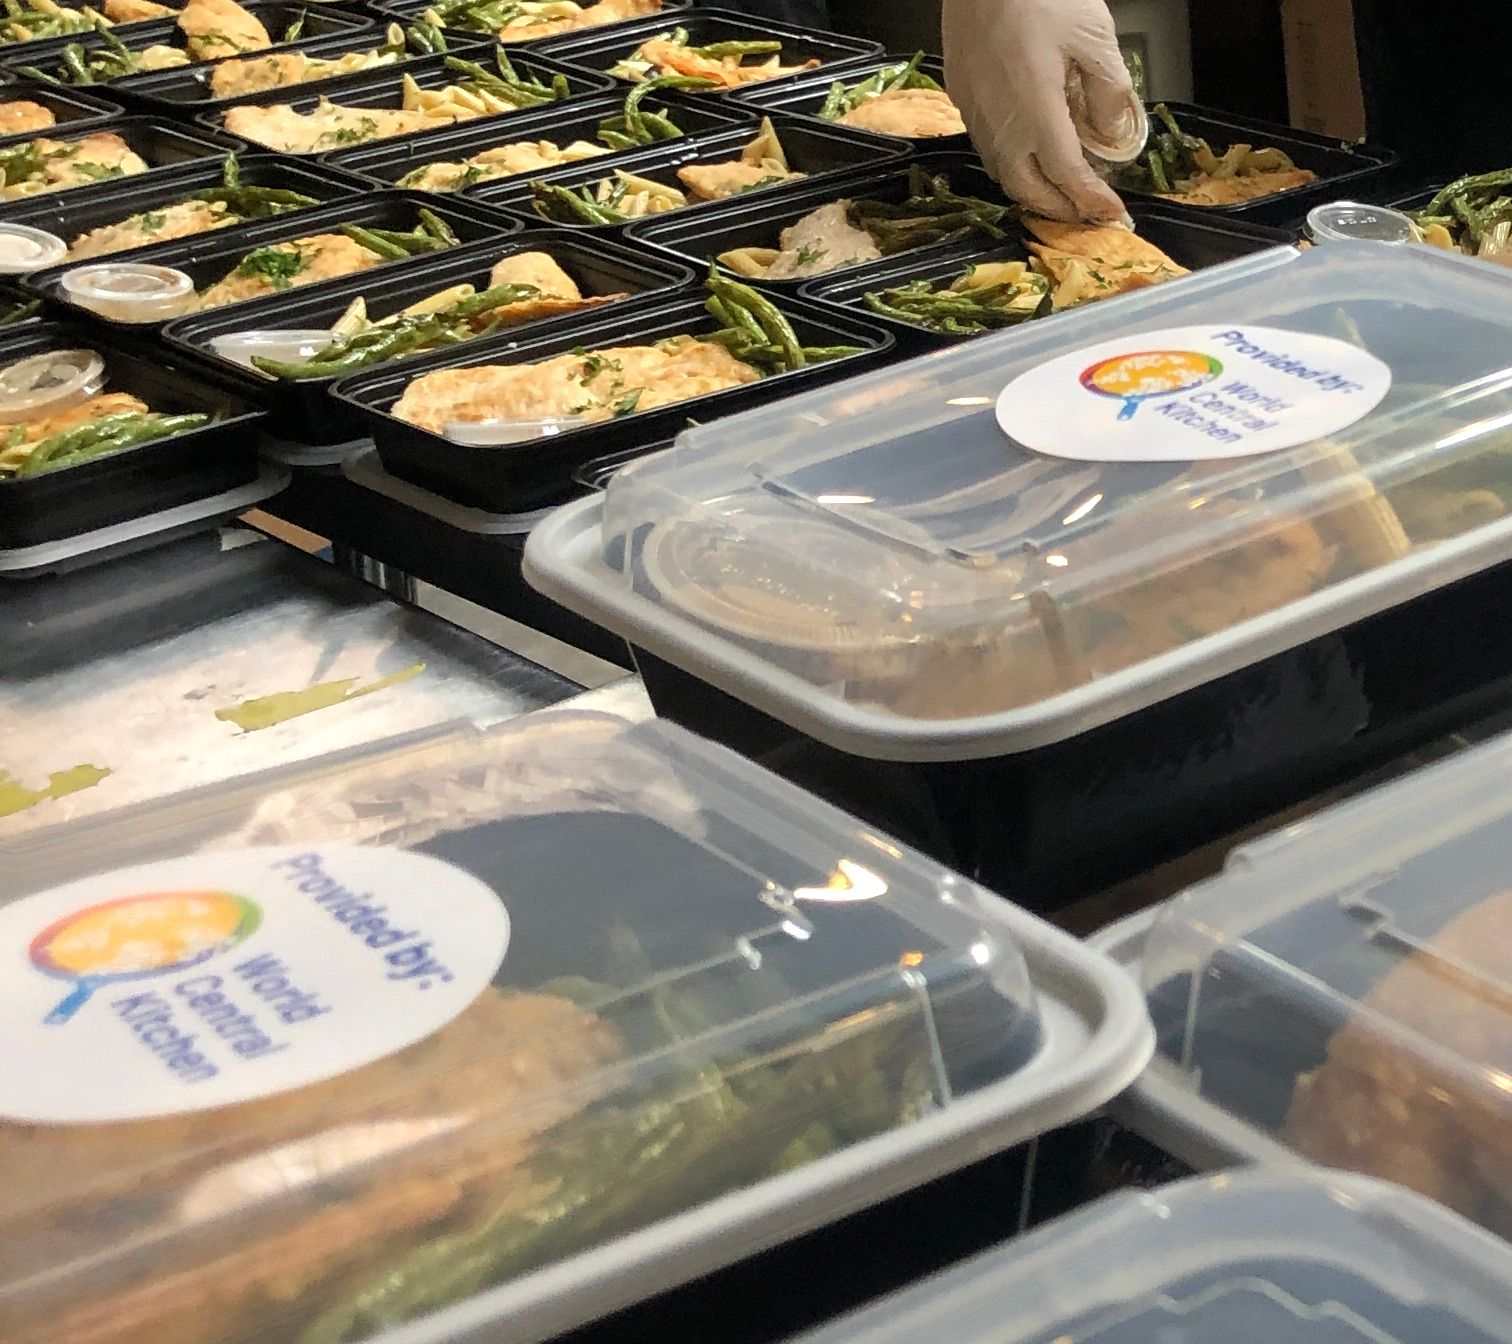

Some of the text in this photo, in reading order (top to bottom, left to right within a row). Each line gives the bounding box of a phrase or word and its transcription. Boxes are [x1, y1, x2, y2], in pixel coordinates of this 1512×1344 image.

[1210, 330, 1363, 394] Provided by:
[1155, 400, 1243, 445] Kitchen
[1189, 391, 1278, 432] Central
[1220, 381, 1294, 414] World
[270, 852, 455, 990] Provided by:
[175, 974, 290, 1060] Central
[233, 954, 333, 1024] World
[110, 990, 219, 1083] Kitchen
